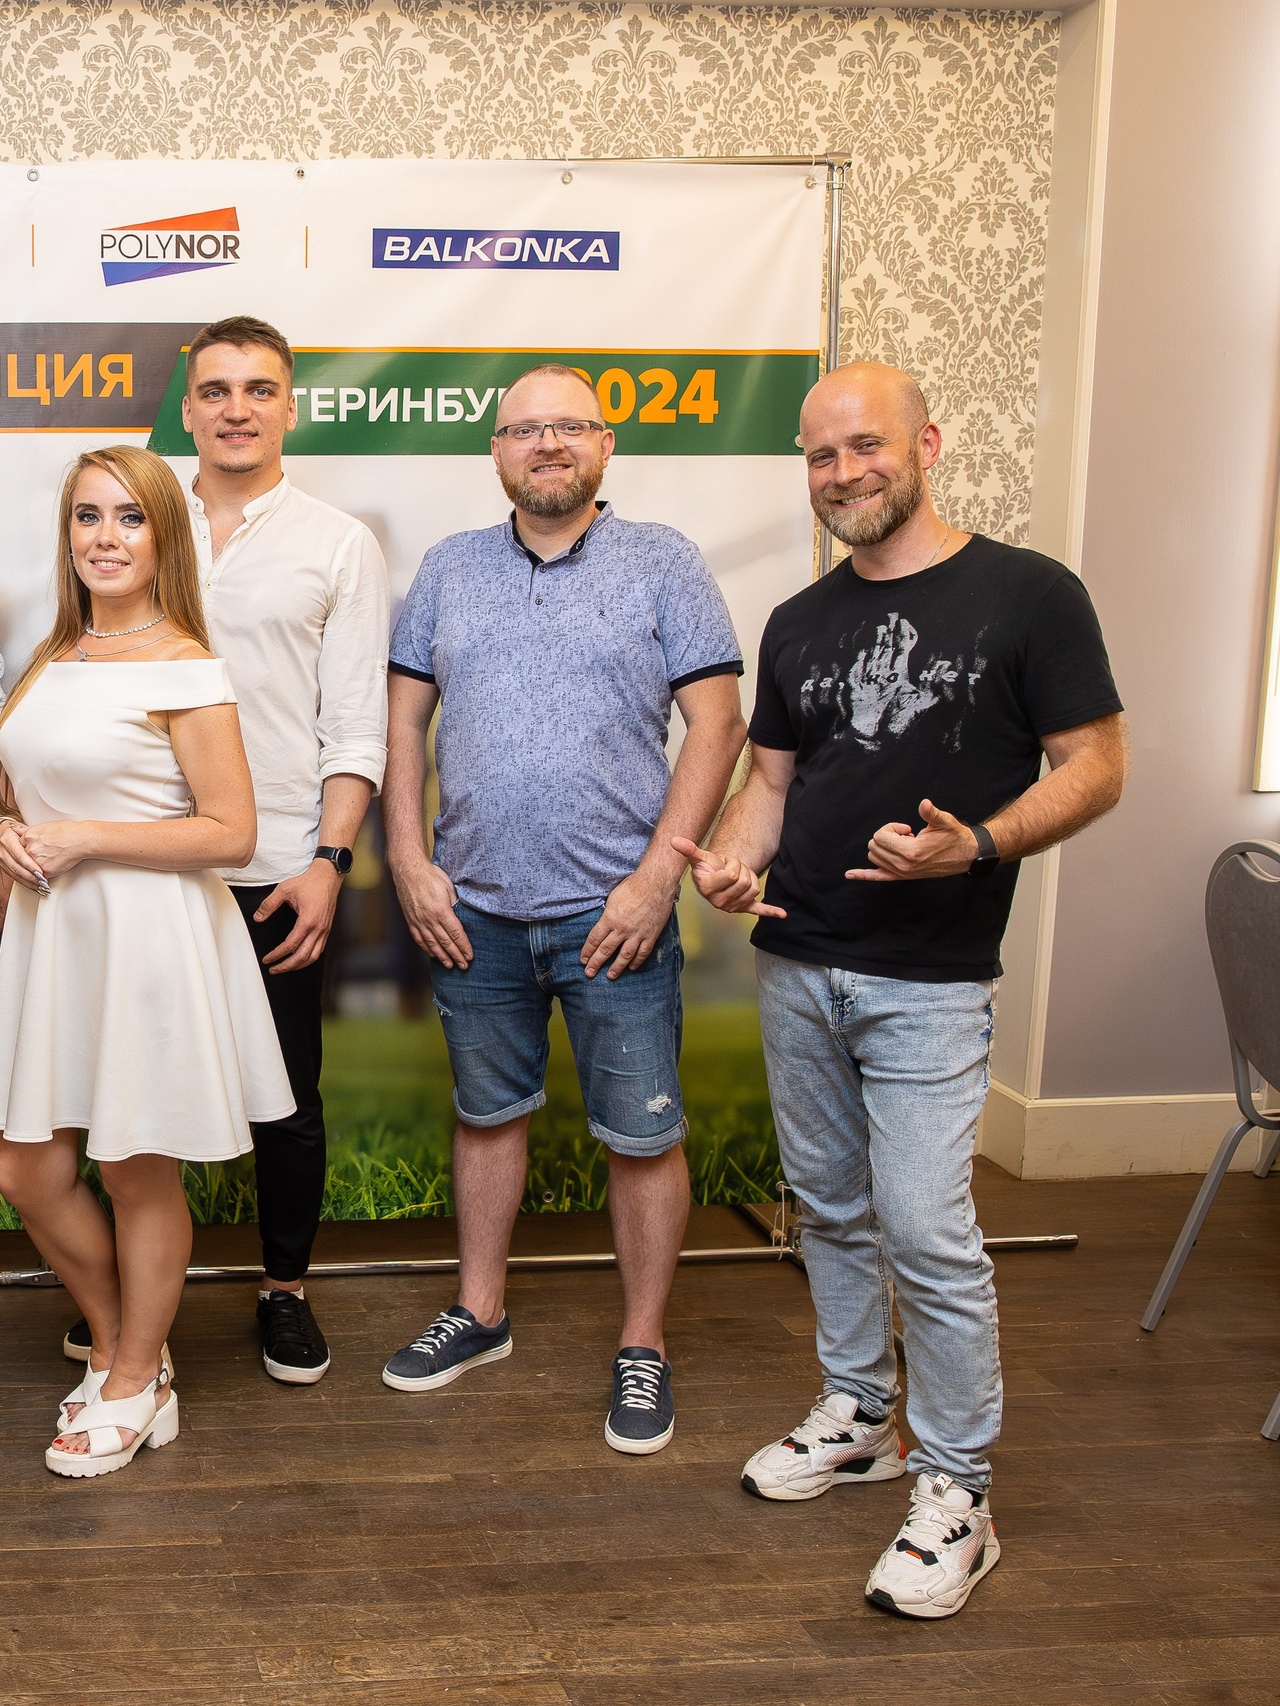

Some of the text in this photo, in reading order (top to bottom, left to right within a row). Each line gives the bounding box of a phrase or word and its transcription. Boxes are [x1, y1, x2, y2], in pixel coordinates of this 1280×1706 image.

[100, 233, 241, 259] POLYNOR
[383, 236, 611, 263] BALKONKA
[570, 367, 719, 425] 024
